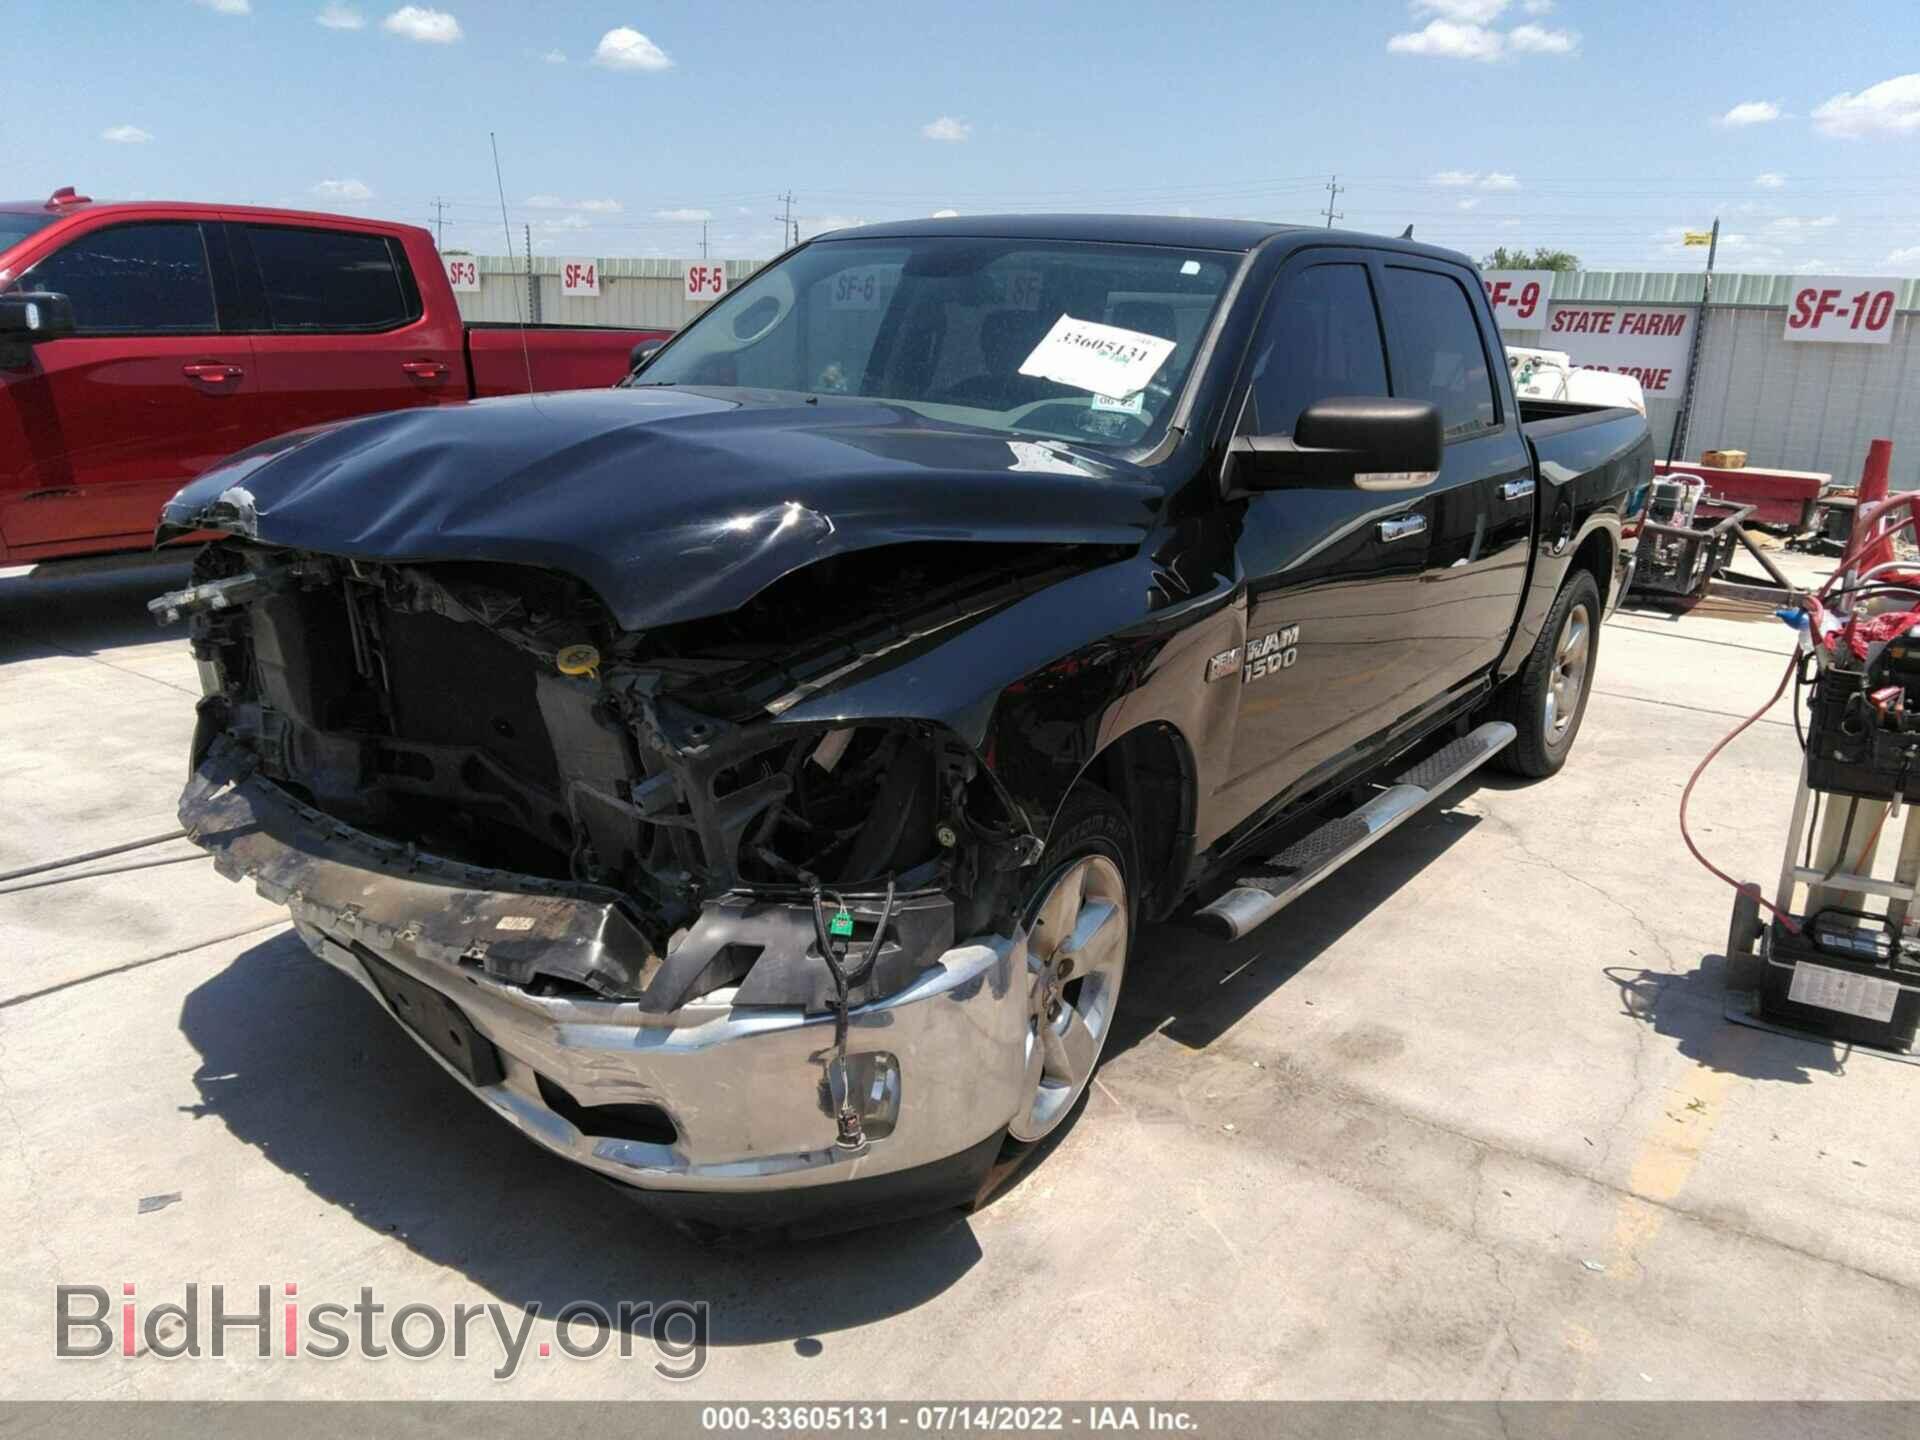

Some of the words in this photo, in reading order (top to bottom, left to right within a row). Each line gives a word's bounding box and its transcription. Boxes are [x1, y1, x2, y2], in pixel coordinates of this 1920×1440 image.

[450, 262, 475, 285] SF-3
[565, 263, 594, 289] SF-4
[689, 267, 721, 293] SF-5
[1551, 310, 1616, 334] STATE
[1618, 312, 1687, 336] FARM
[1788, 288, 1895, 331] SF-10
[1056, 331, 1148, 362] 33605131
[1247, 624, 1300, 661] RAM
[1242, 648, 1297, 683] 1500
